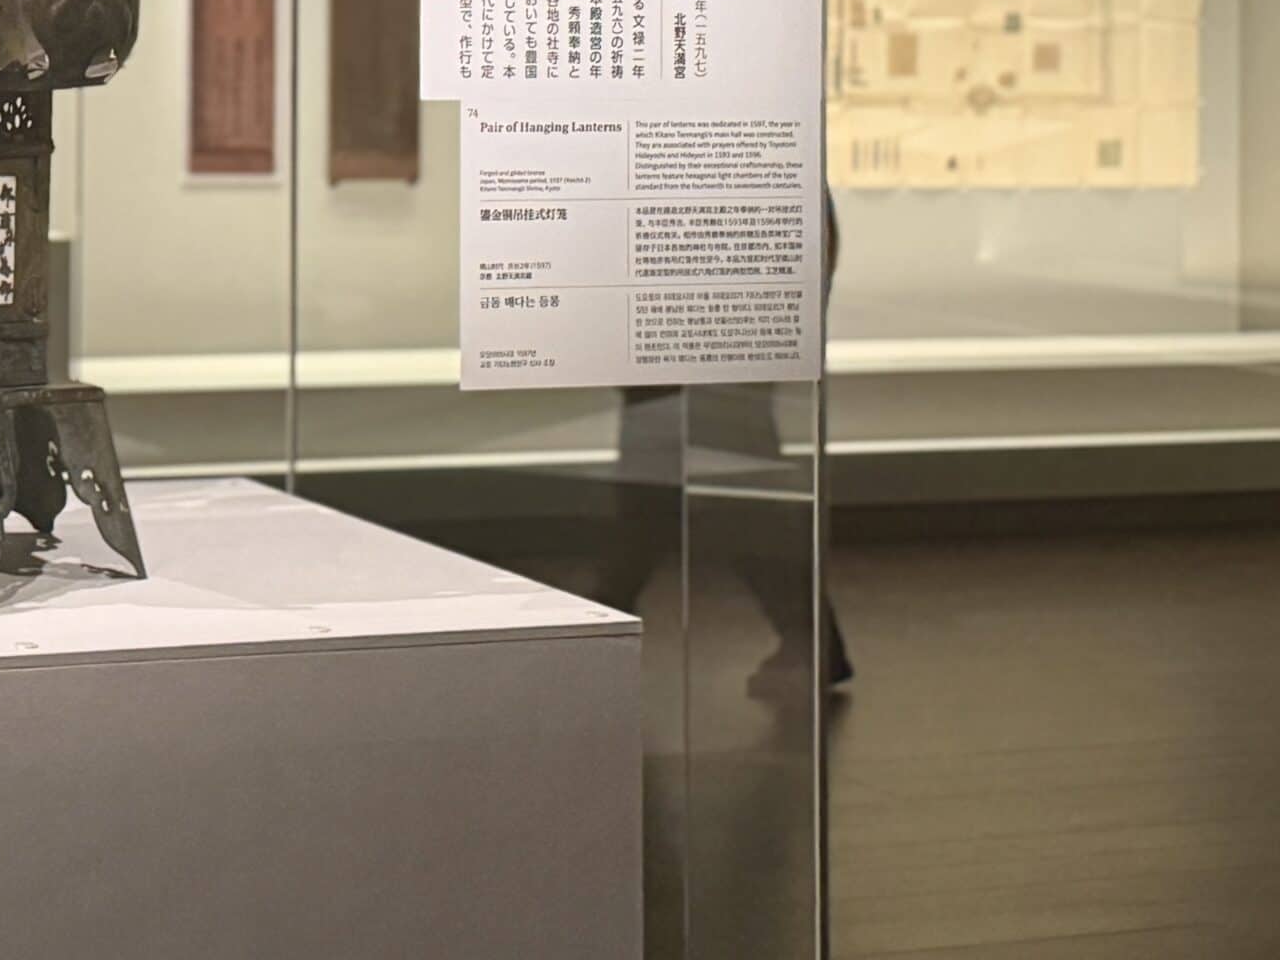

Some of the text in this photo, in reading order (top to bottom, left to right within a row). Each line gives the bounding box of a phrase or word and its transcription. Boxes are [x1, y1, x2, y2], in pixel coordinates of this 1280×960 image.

[674, 13, 686, 79] 北野天満宮
[467, 108, 478, 118] 74
[480, 121, 622, 135] Pair of Hanging Lanterns
